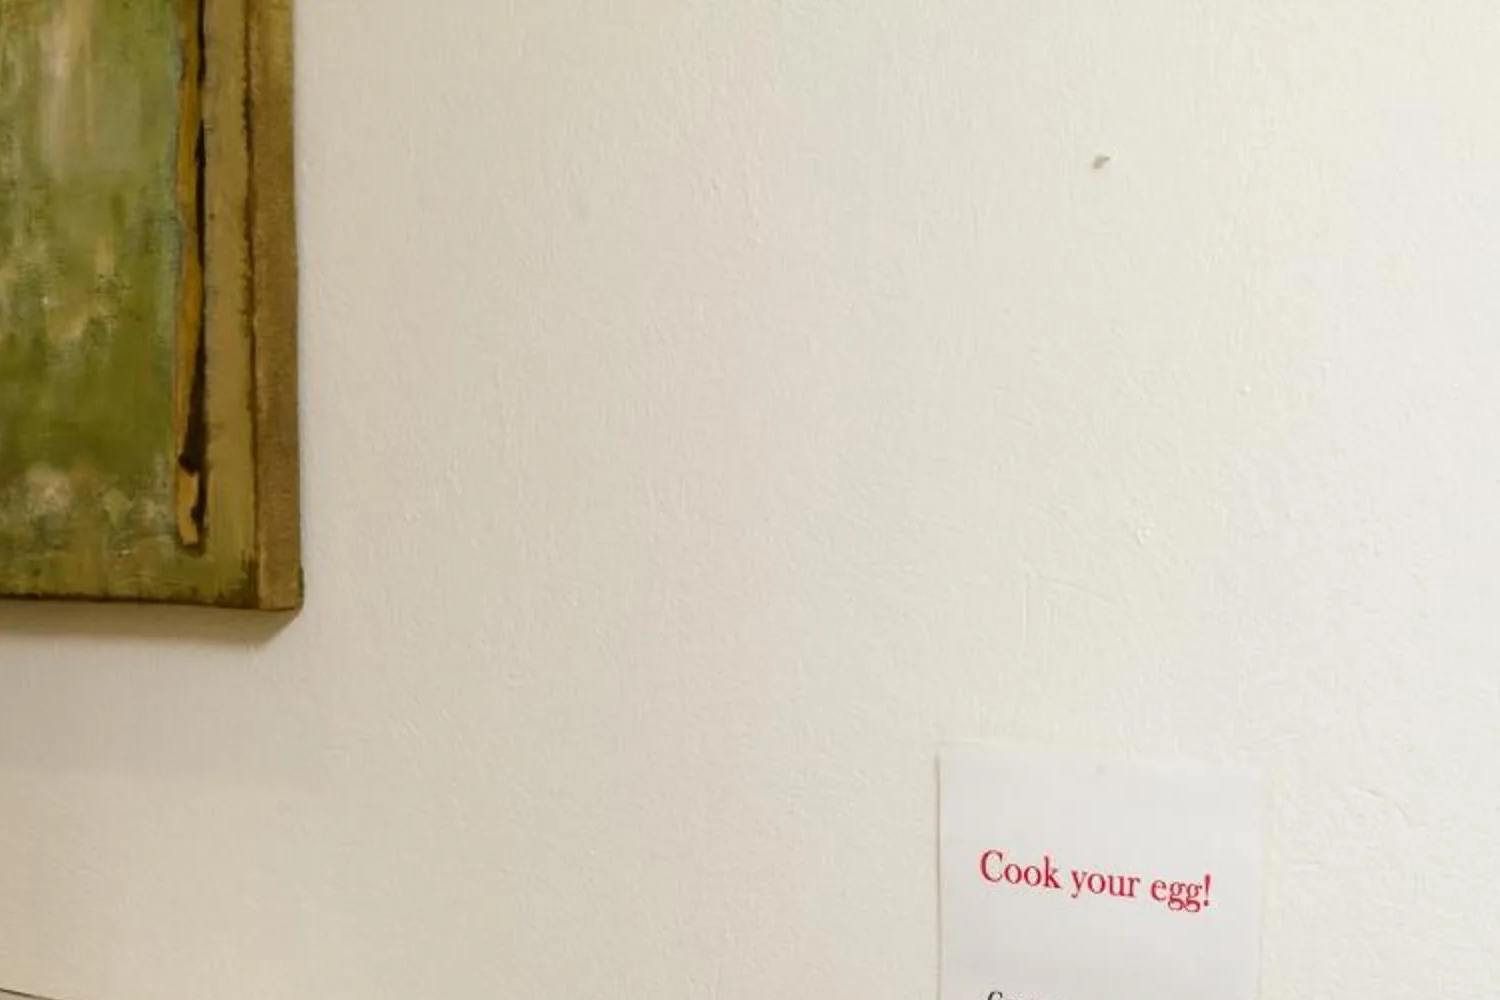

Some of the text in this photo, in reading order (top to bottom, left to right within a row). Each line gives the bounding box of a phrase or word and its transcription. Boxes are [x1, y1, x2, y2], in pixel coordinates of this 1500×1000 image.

[979, 849, 1212, 913] Cook your egg!
